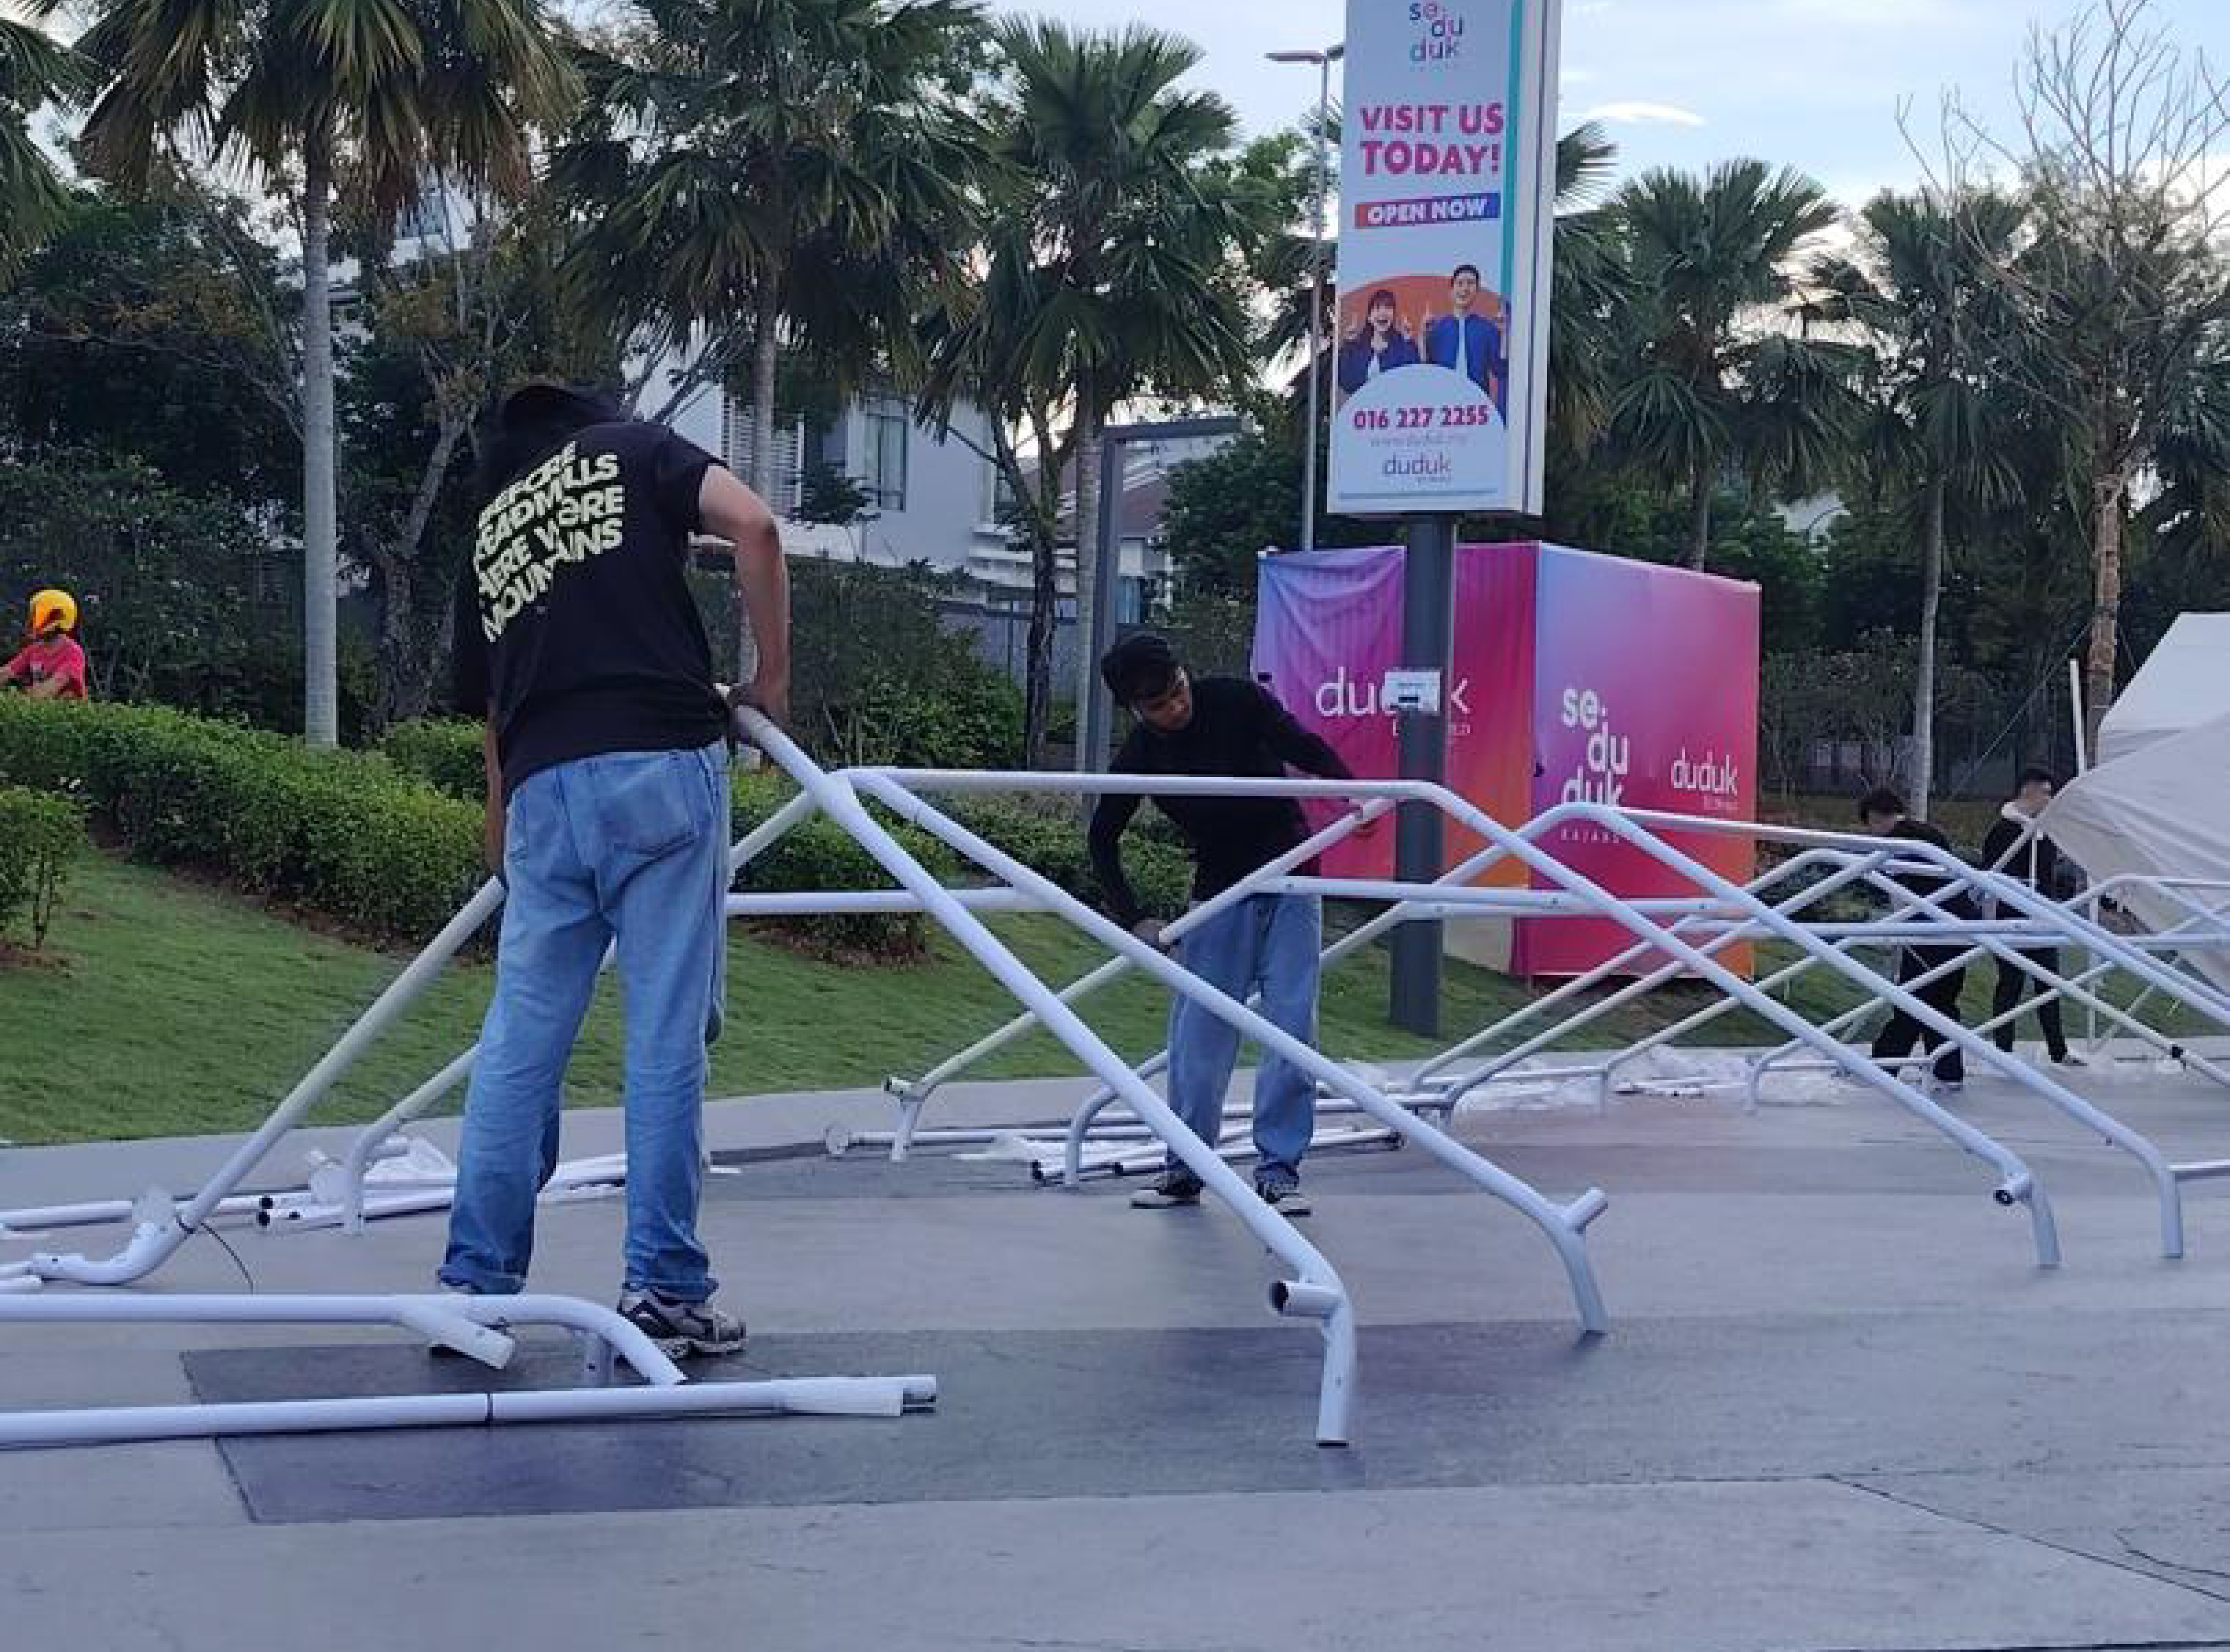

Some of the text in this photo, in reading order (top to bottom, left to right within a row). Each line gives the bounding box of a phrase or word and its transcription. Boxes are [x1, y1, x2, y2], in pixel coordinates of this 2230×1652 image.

[1431, 14, 1463, 37] du
[1409, 37, 1460, 61] duk
[1360, 102, 1504, 134] VISIT US
[1360, 141, 1498, 175] TODAY!
[1368, 200, 1488, 224] OPEN NOW
[1354, 404, 1488, 431] 016 227 2255
[1382, 451, 1451, 475] duduk
[1588, 721, 1628, 775] du
[1671, 746, 1738, 797] duduk
